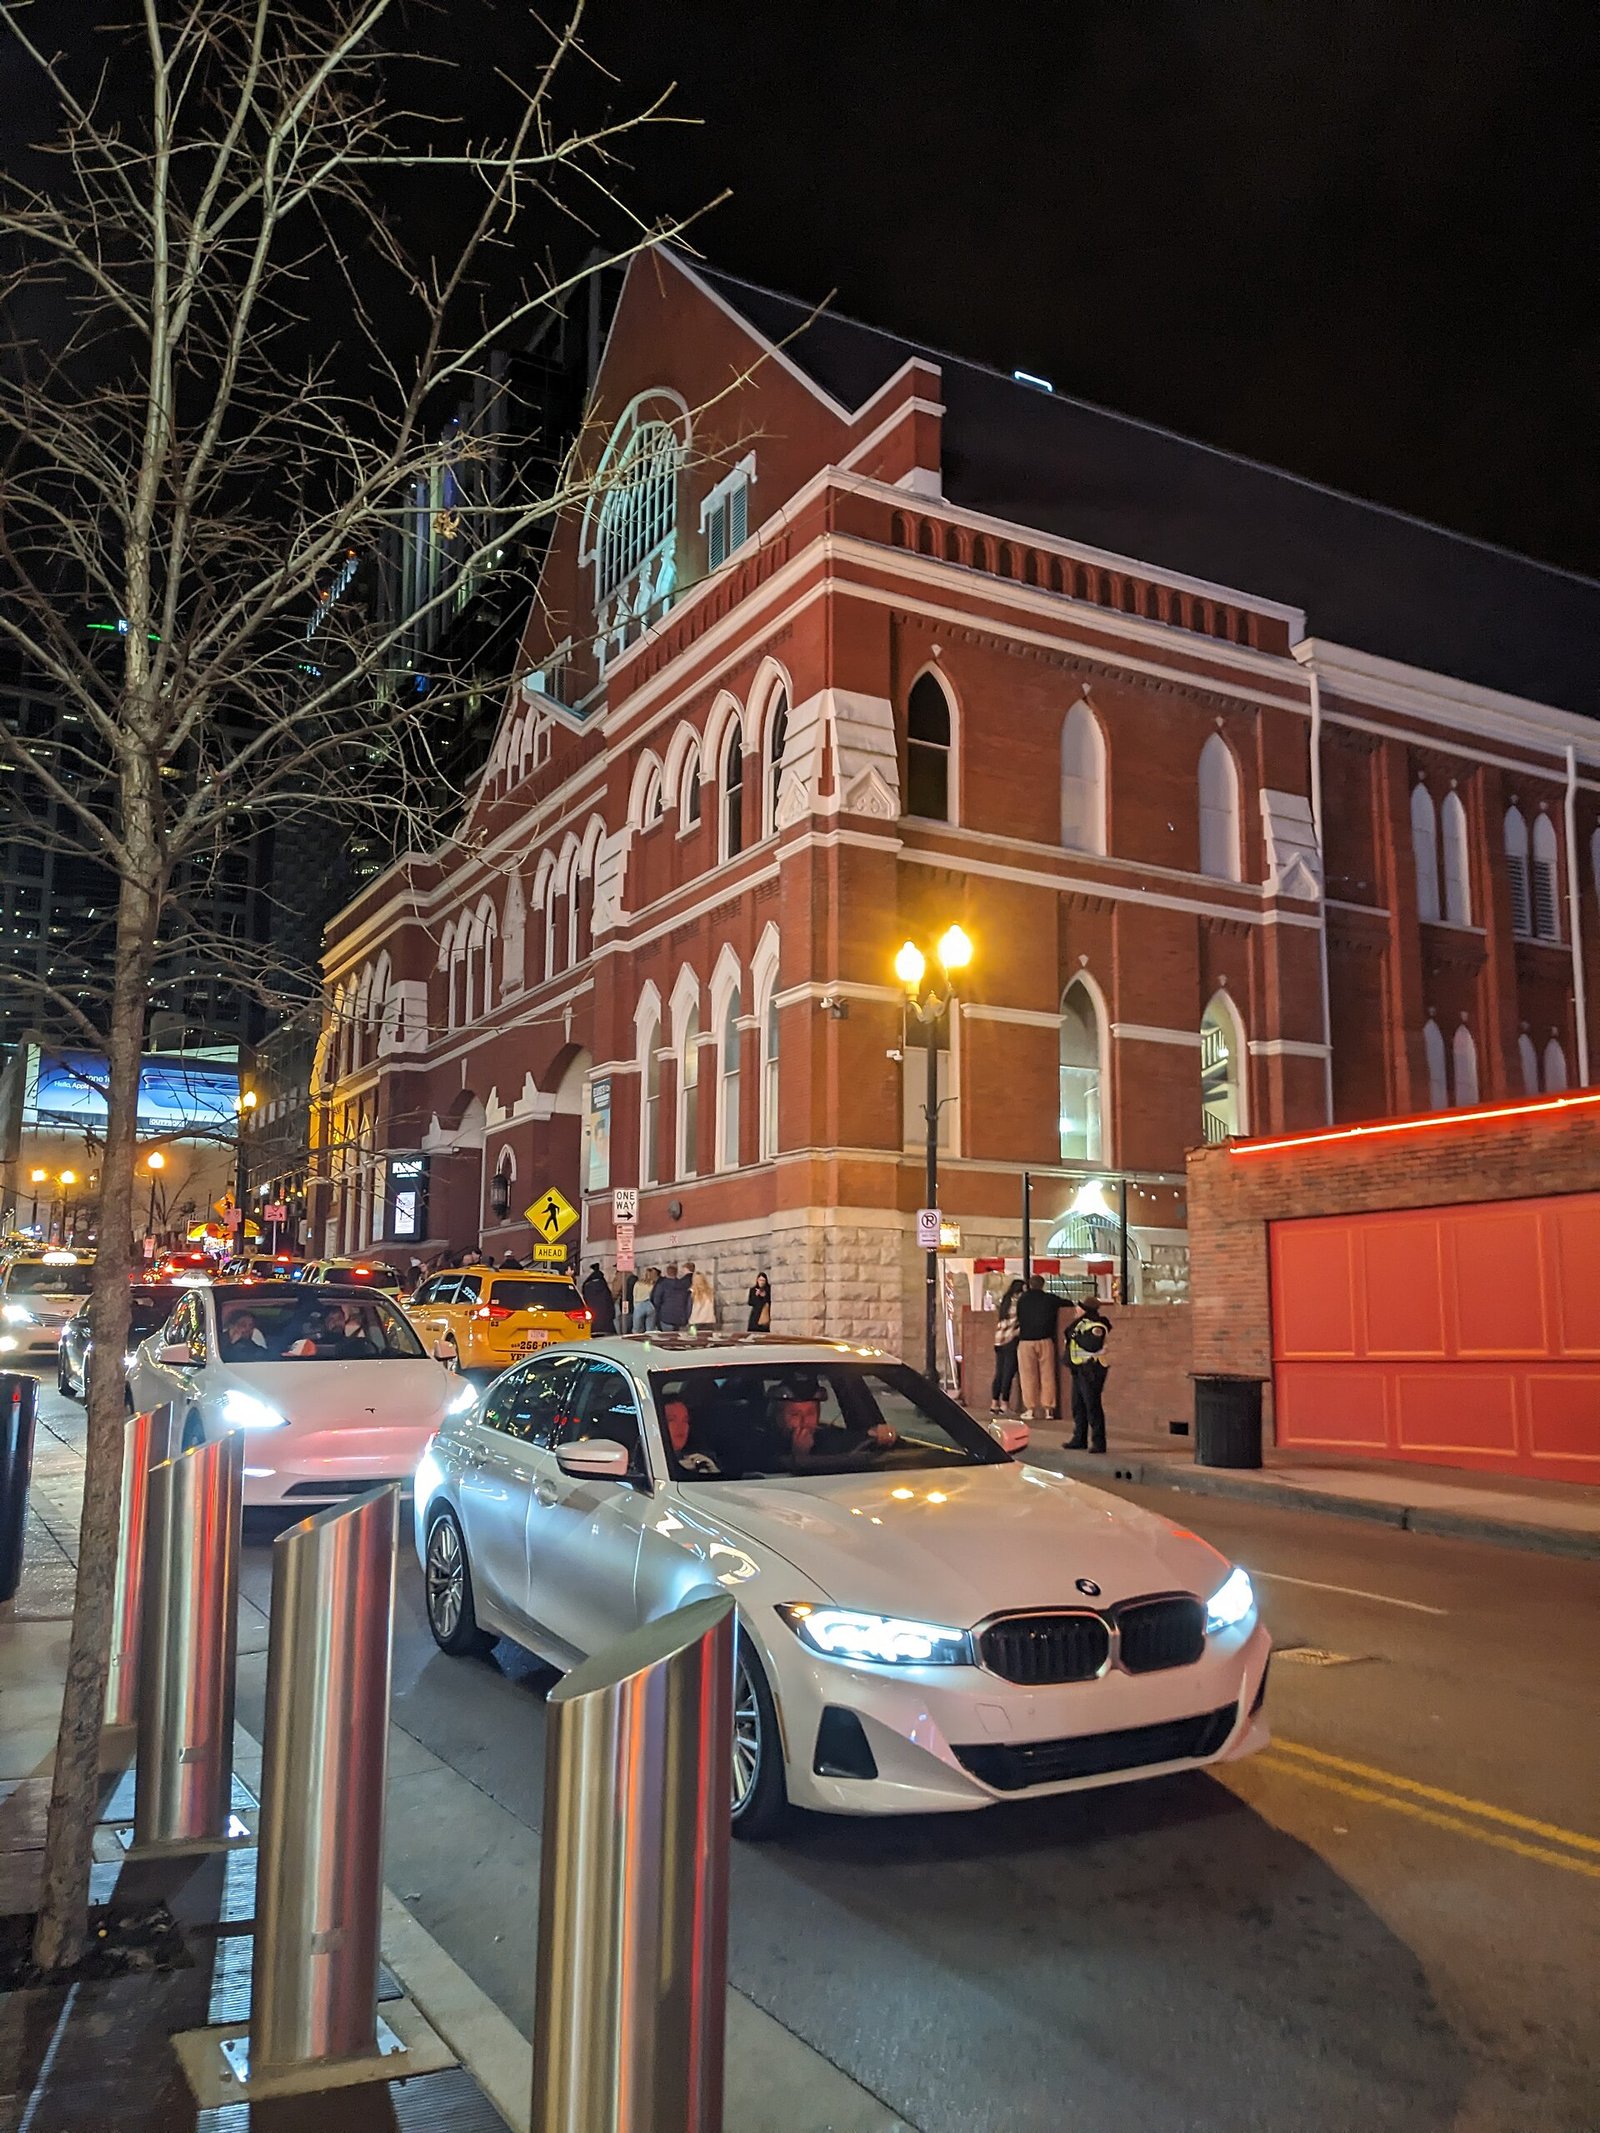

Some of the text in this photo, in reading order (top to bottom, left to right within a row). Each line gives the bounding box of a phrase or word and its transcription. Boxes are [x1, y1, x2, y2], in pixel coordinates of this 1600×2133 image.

[616, 1191, 635, 1200] ONE
[616, 1202, 635, 1210] WAY
[538, 1249, 562, 1257] AHEAD
[520, 1341, 557, 1350] 256-01
